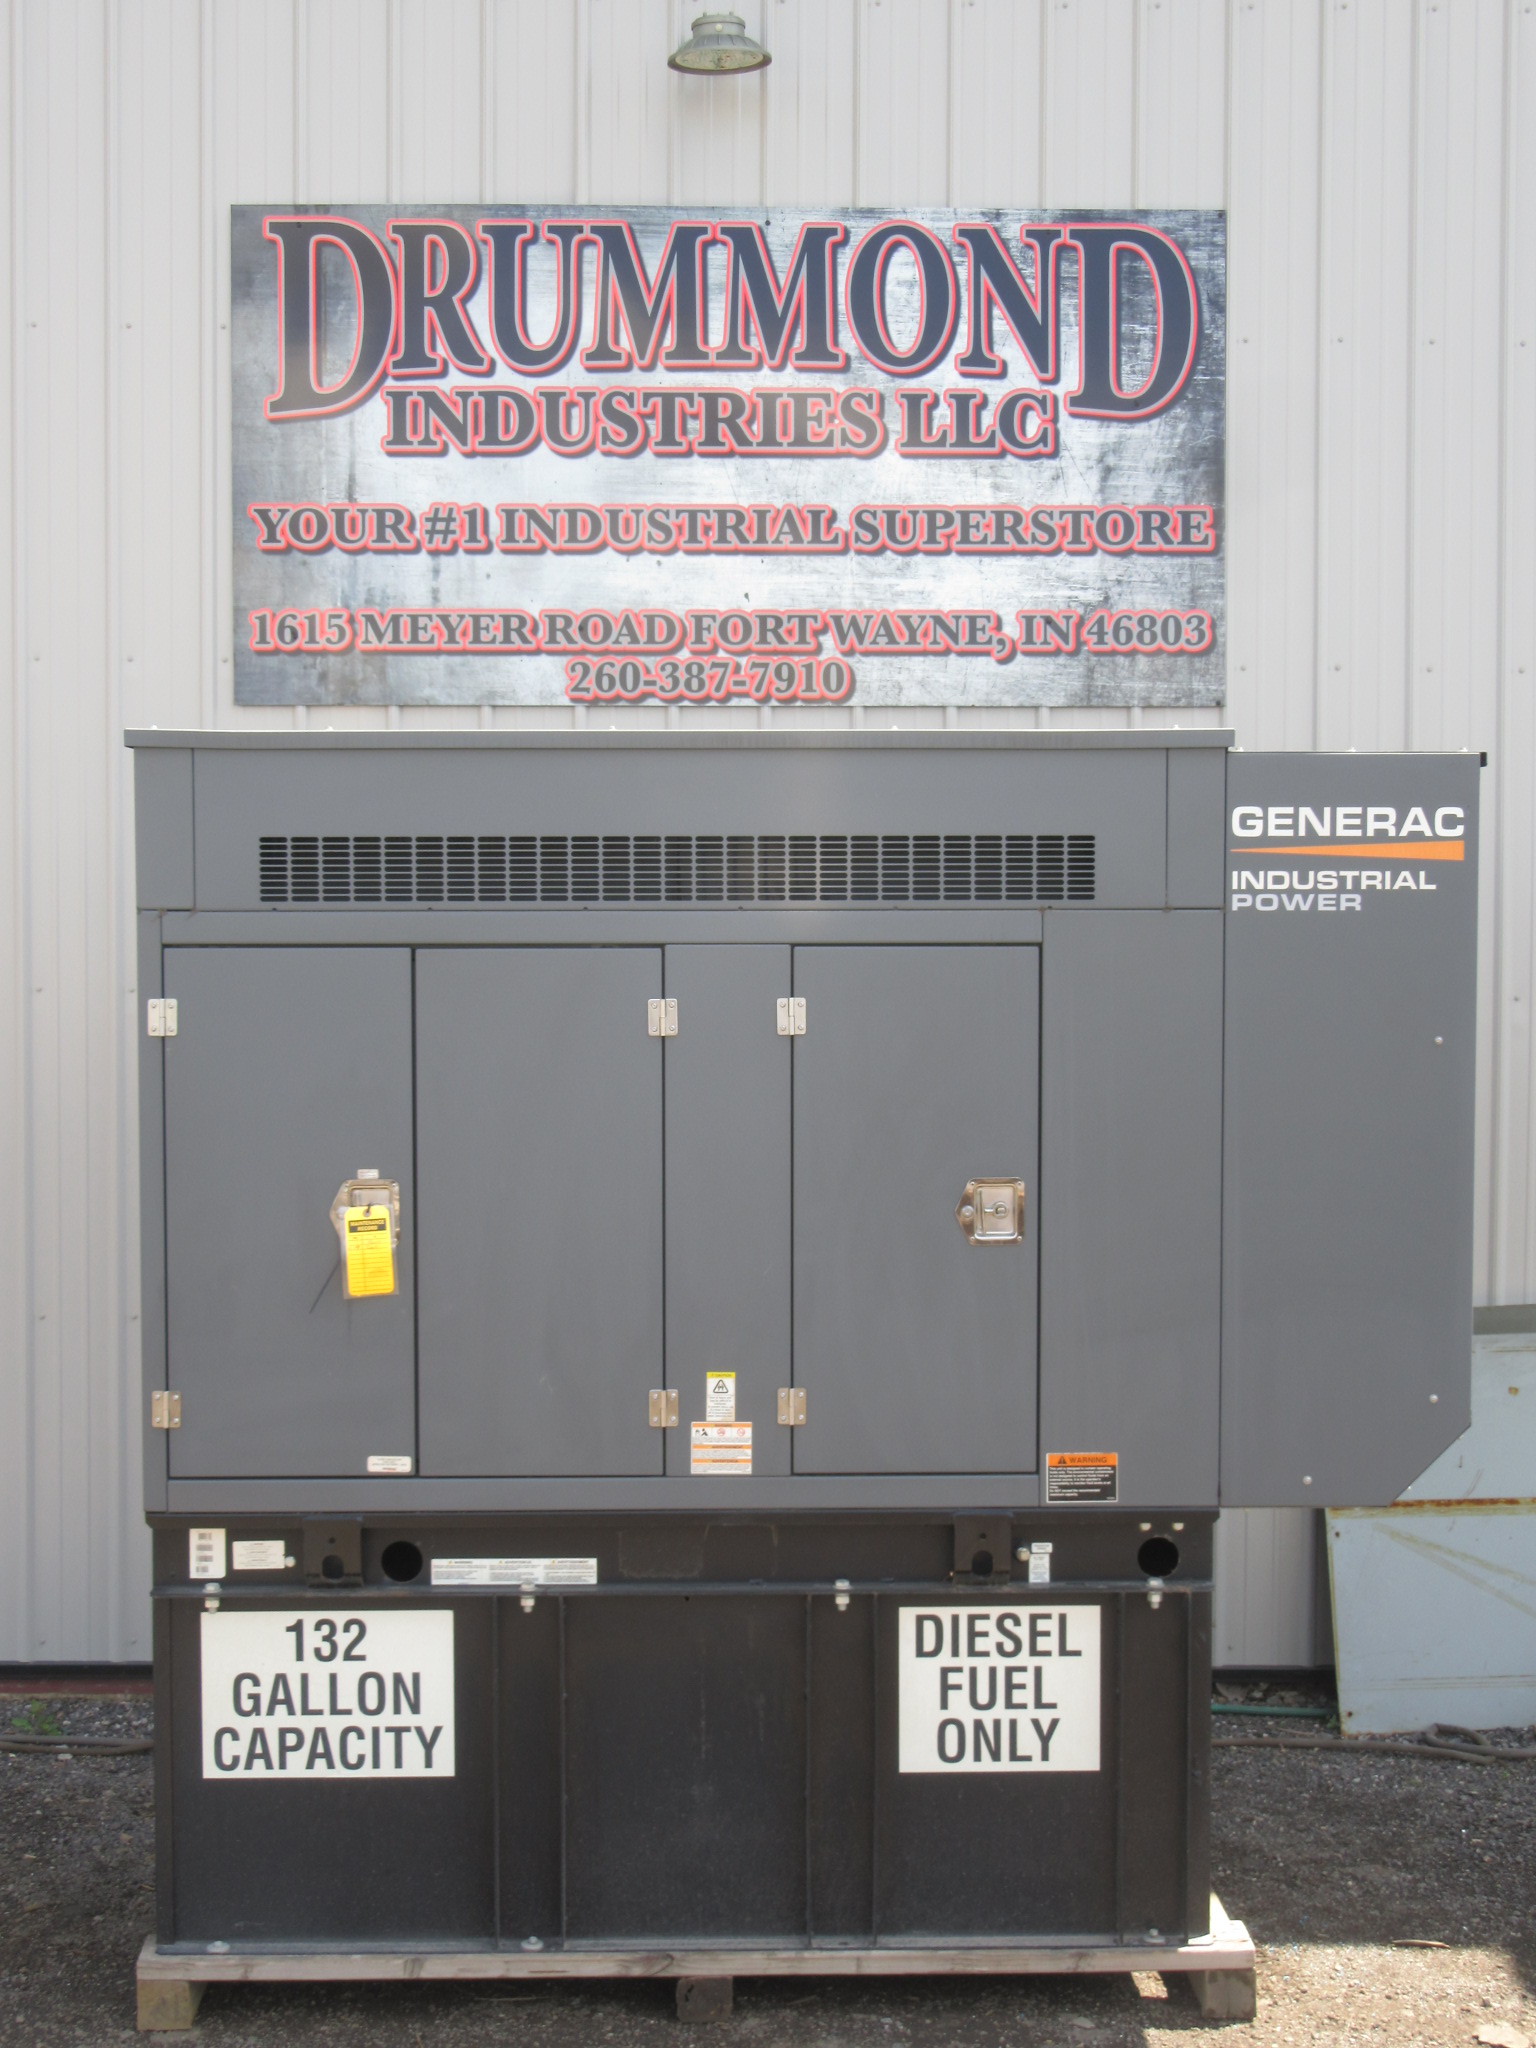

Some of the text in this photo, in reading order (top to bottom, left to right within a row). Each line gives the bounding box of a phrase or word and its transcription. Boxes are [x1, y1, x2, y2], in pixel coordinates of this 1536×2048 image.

[264, 216, 1198, 419] DRUMMOND
[382, 386, 1055, 455] INDUSTRIES LLC
[249, 503, 1214, 551] YOUR #1 INDUSTRIAL SUPERSTORE
[250, 609, 1212, 660] 1615 MEYER ROAD FORT WAYNE, IN 46803
[566, 658, 852, 702] 260-387-7910
[1231, 806, 1465, 837] GENERAC
[1231, 871, 1437, 890] INDUSTRIAL
[1231, 893, 1362, 911] POWER
[1068, 1456, 1108, 1464] WARNING
[286, 1618, 367, 1662] 132
[915, 1612, 1082, 1658] DIESEL
[232, 1671, 421, 1717] GALLON
[939, 1666, 1058, 1710] FUEL
[213, 1725, 443, 1771] CAPACITY
[937, 1717, 1060, 1763] ONLY
